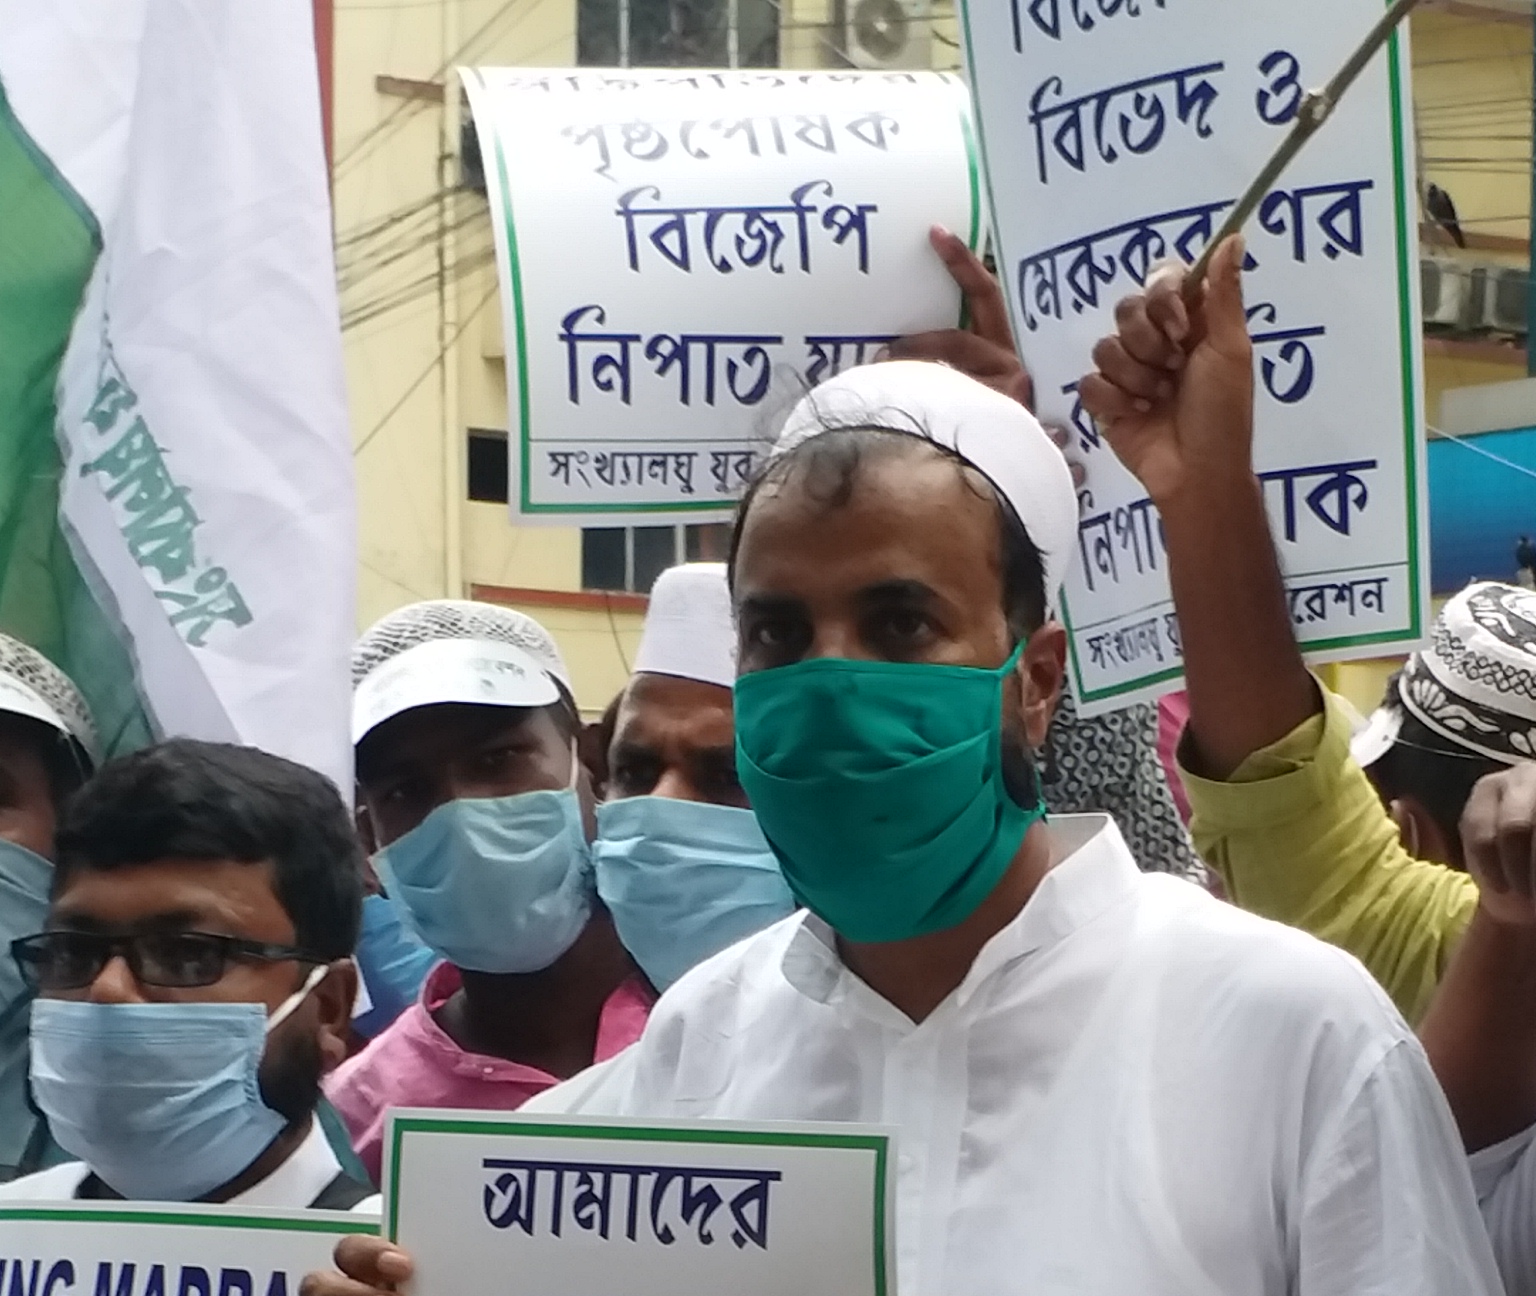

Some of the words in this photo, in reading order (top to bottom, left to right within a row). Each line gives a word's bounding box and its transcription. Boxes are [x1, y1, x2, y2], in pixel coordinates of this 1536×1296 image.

[1028, 61, 1224, 184] বিভেদ
[1256, 49, 1303, 125] ও
[615, 180, 879, 276] বিজেপি
[557, 304, 783, 408] নিপাত
[547, 450, 698, 494] সংখ্যালঘু
[1257, 459, 1377, 543] াক
[482, 1159, 780, 1251] আমাদের
